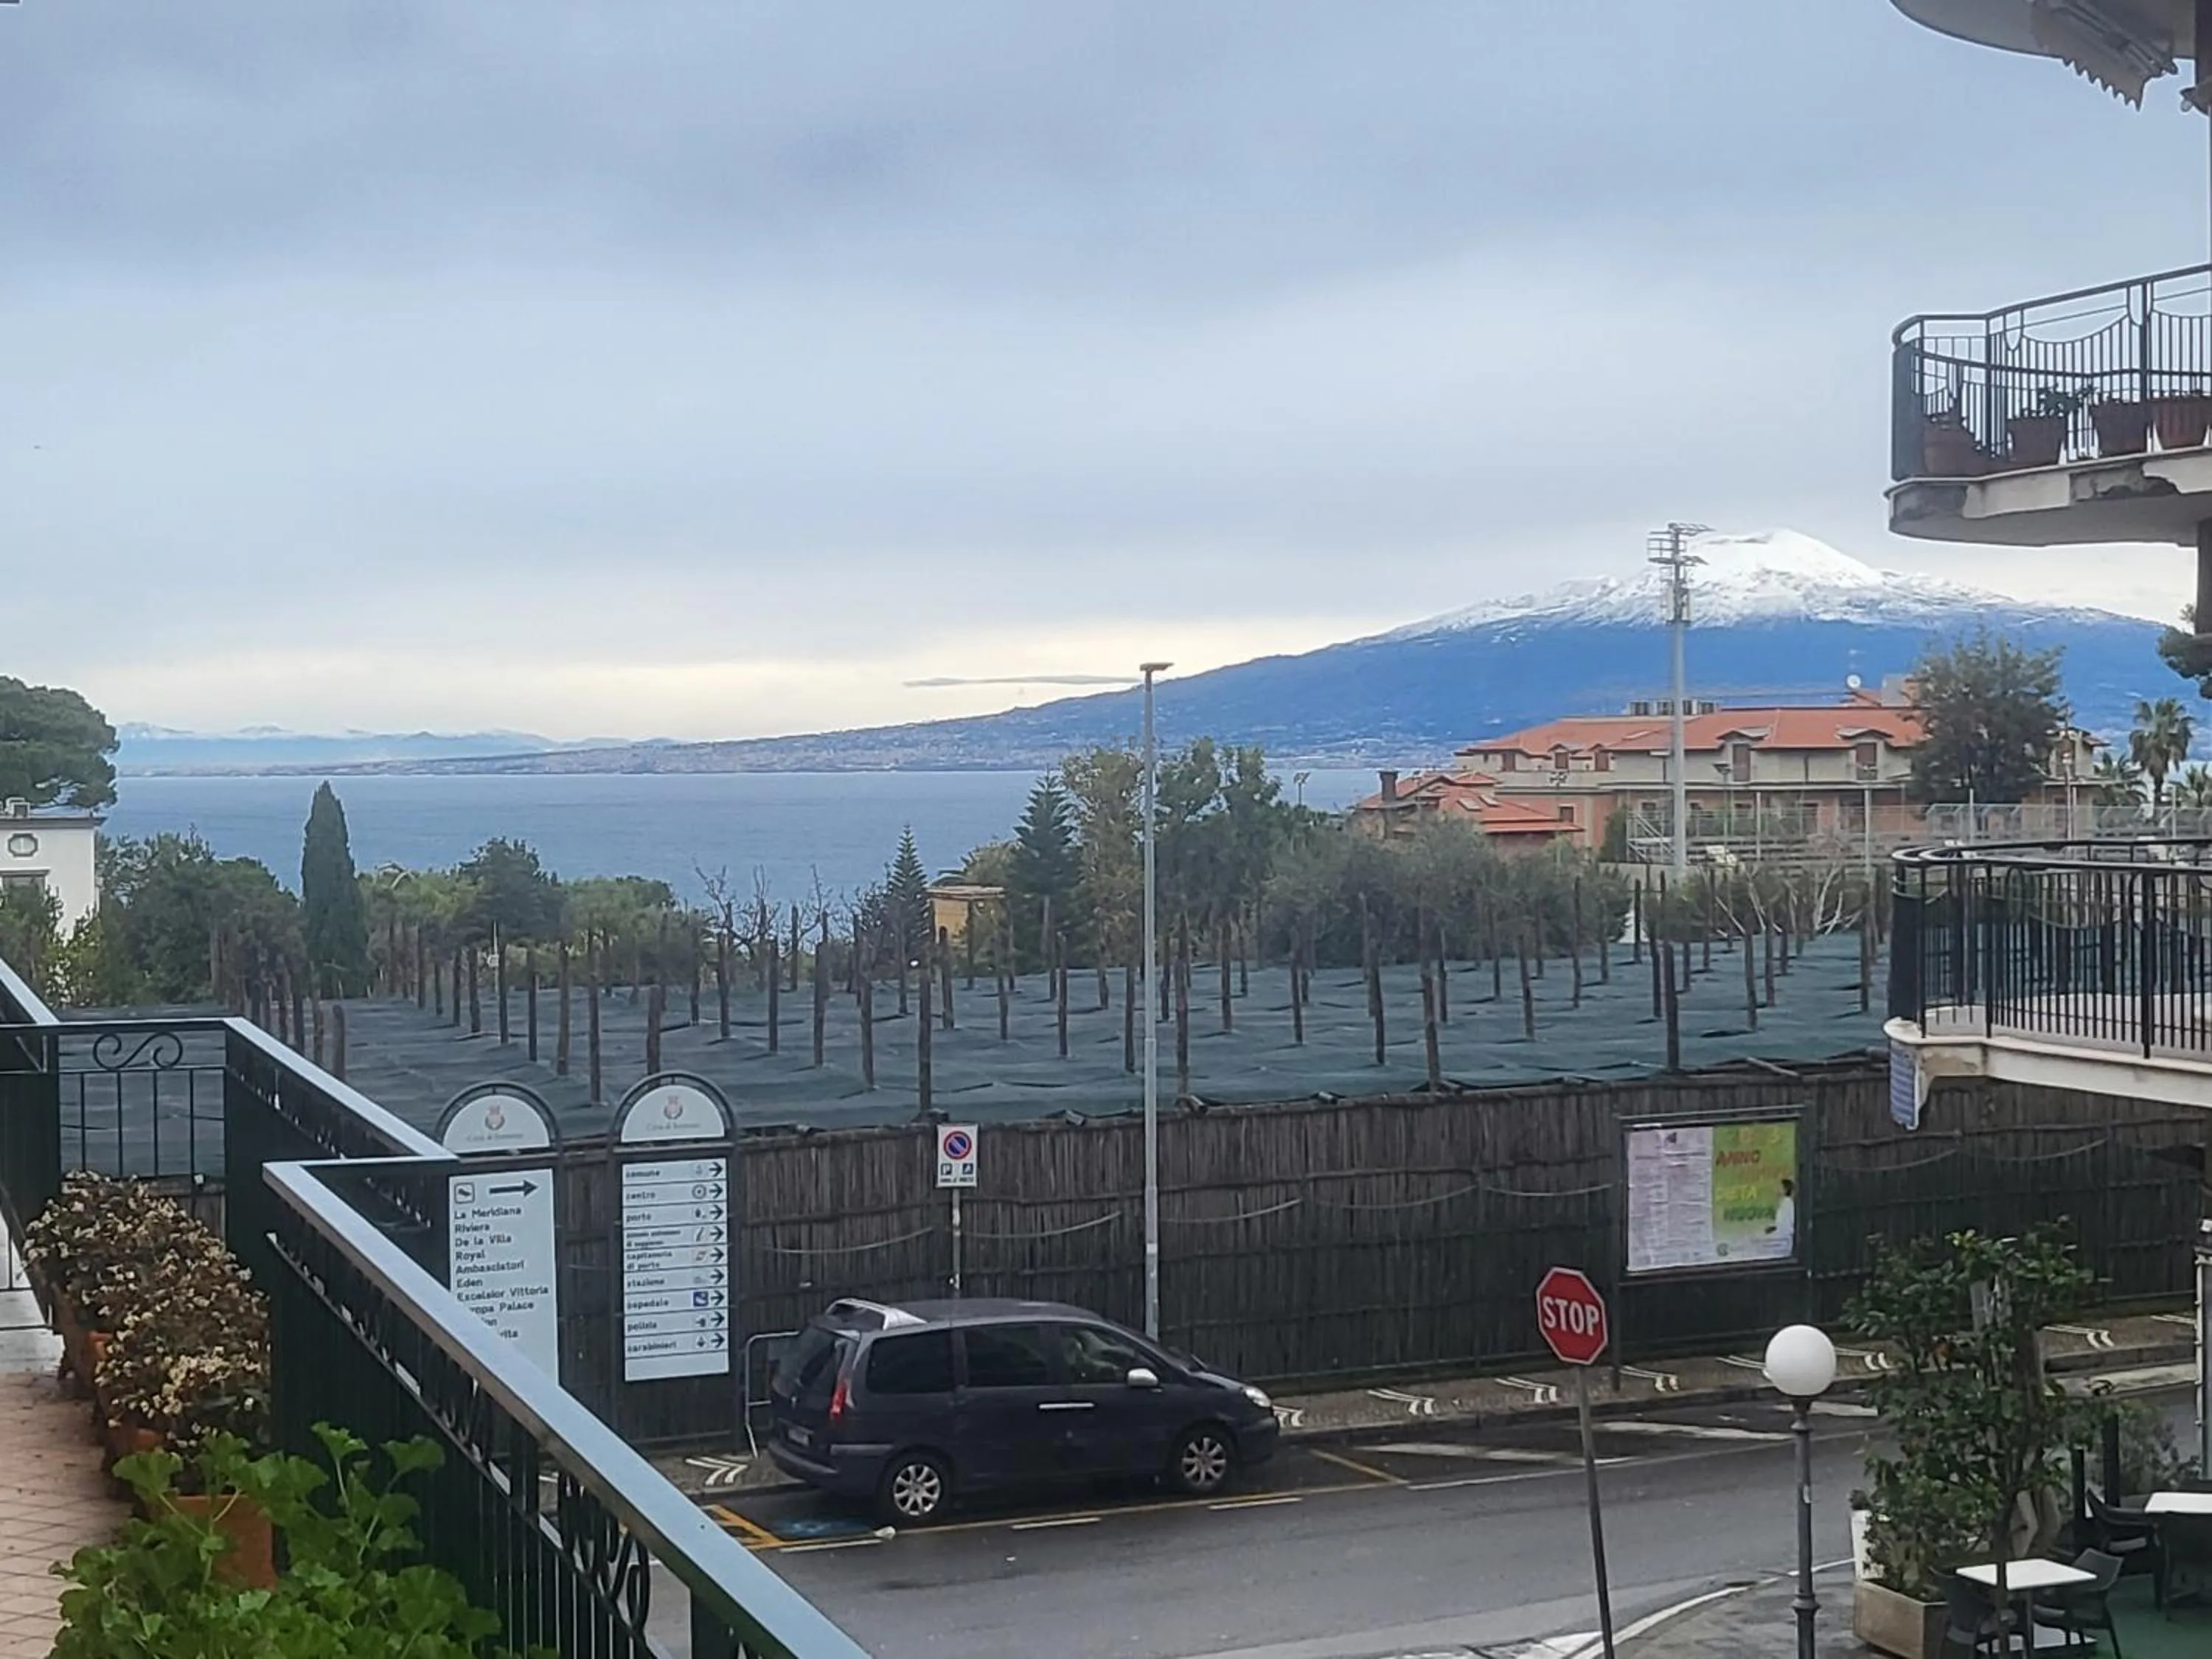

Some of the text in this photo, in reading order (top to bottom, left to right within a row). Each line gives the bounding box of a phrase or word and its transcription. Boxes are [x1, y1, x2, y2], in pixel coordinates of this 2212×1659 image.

[454, 1207, 521, 1220] La Meridiana
[454, 1223, 490, 1233] Riviera
[455, 1238, 469, 1247] De
[474, 1235, 484, 1245] la
[456, 1250, 485, 1262] Royal
[456, 1260, 524, 1274] Ambasciatori
[456, 1279, 483, 1288] Eden
[457, 1286, 549, 1301] Excelsior Vittoria
[470, 1301, 534, 1315] ropa Palace
[1543, 1296, 1599, 1336] STOP
